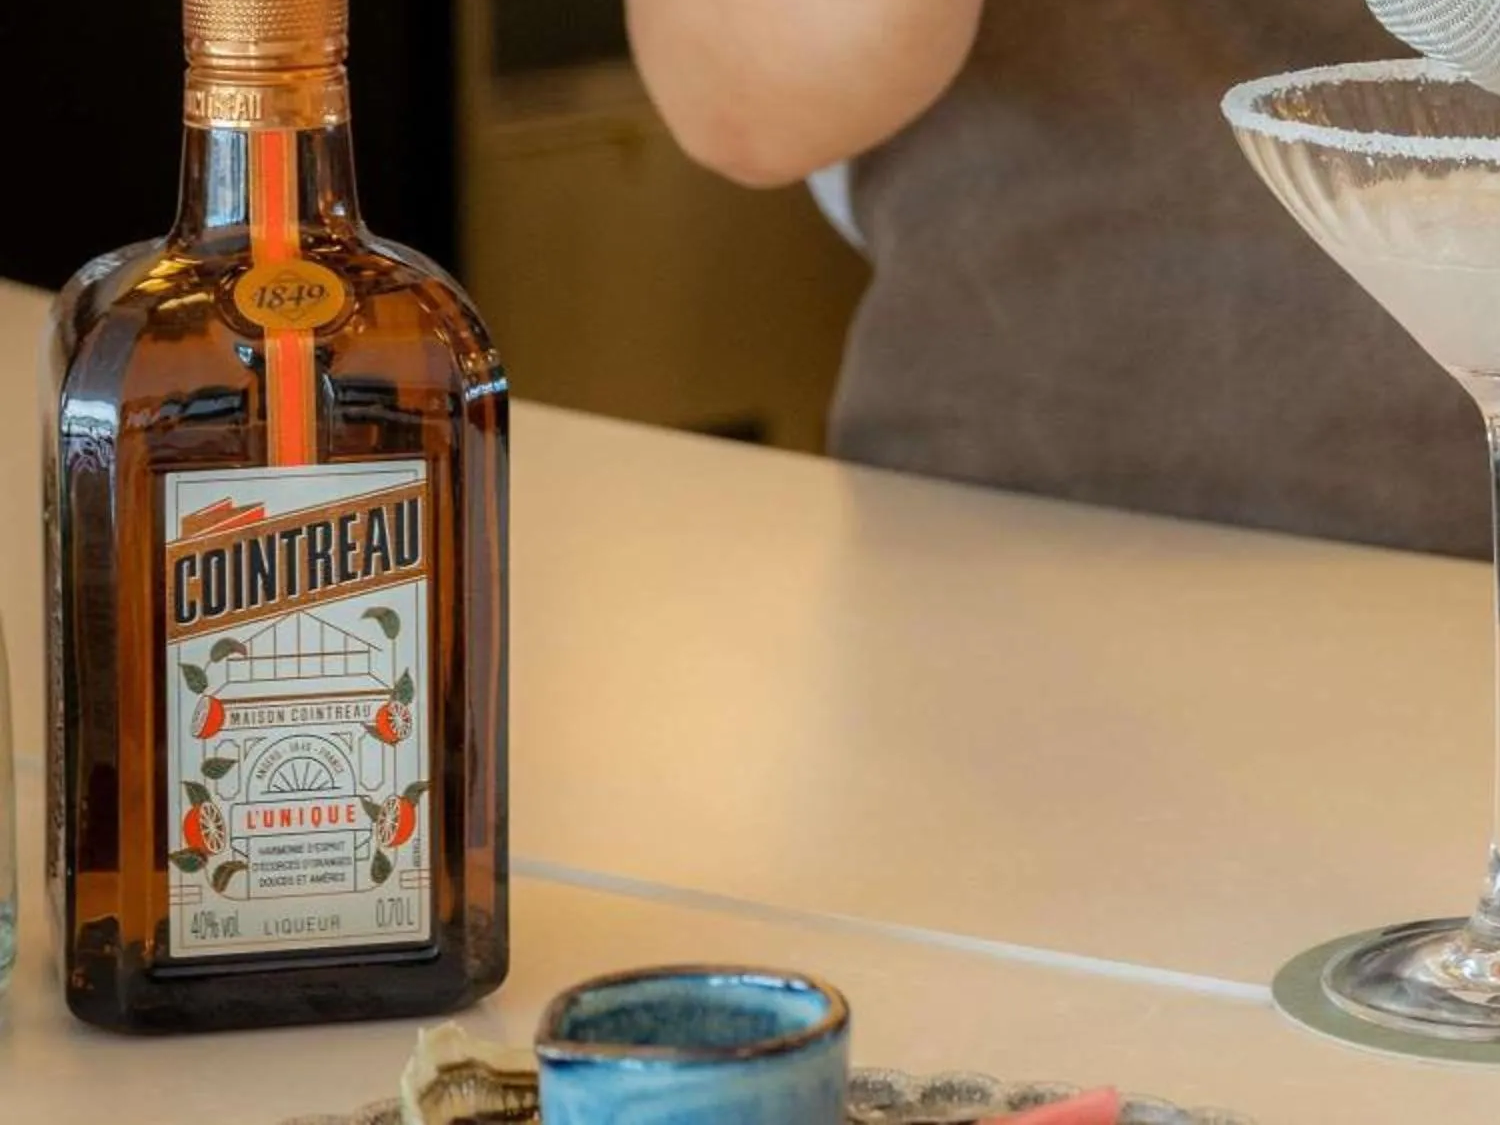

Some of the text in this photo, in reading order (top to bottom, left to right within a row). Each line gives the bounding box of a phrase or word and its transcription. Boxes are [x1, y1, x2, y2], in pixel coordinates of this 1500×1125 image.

[255, 283, 325, 309] 1849
[174, 496, 423, 625] COINTREAU
[230, 704, 372, 725] MAISON COINTREAU
[246, 803, 357, 829] L'UNIQUE
[262, 914, 341, 937] LIQUEUR
